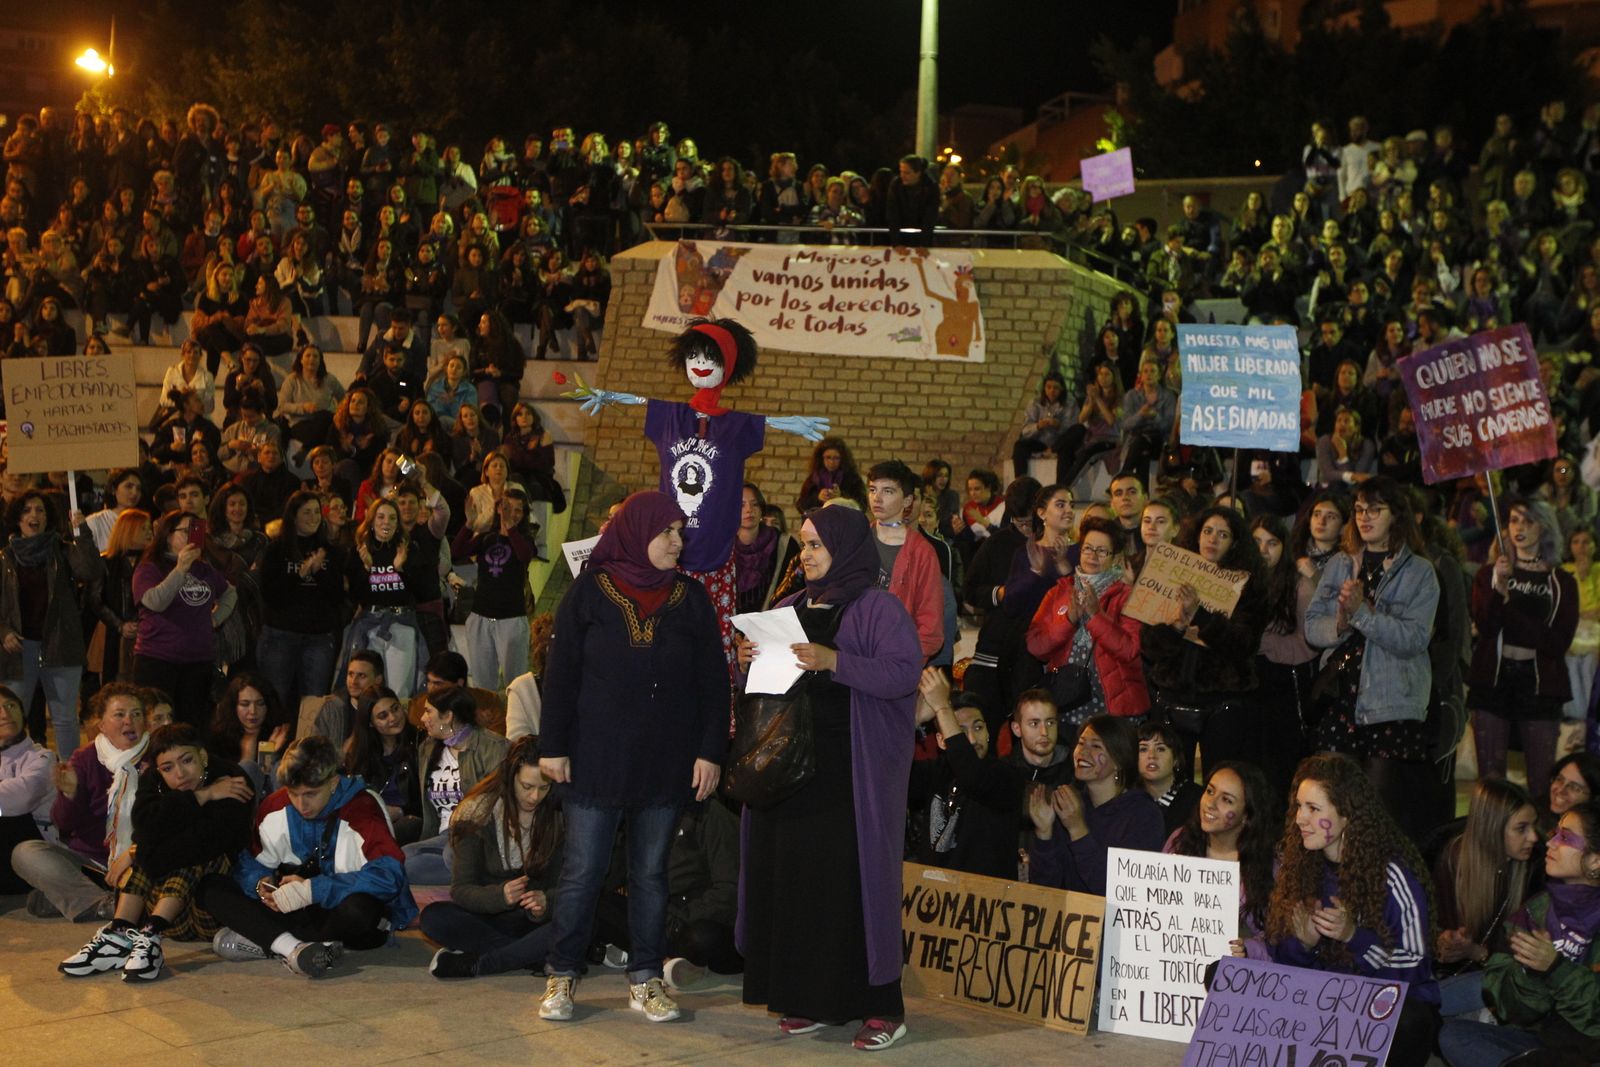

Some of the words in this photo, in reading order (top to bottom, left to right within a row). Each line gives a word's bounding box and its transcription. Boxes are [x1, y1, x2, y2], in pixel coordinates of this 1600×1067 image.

[752, 268, 823, 292] vamos
[831, 268, 909, 292] unidas
[735, 290, 775, 311] por
[781, 289, 811, 311] los
[818, 294, 921, 317] derechos
[769, 312, 795, 330] de
[804, 313, 867, 335] todas
[1185, 333, 1240, 347] MOLESTA
[1187, 353, 1229, 372] MUJER
[1235, 356, 1300, 375] LIBERADA
[1477, 343, 1502, 371] NO
[1501, 337, 1527, 365] SE
[12, 381, 133, 405] EMPODERADAS
[1209, 385, 1238, 398] QUE
[1248, 387, 1275, 400] MIL
[1462, 390, 1487, 415] NO
[1488, 378, 1541, 411] SIENTE
[43, 403, 94, 417] HARTAS
[101, 402, 117, 412] DE
[1442, 424, 1472, 449] SUS
[1477, 402, 1549, 442] CADENAS
[1150, 560, 1168, 572] SE
[1156, 545, 1179, 561] CON
[1180, 554, 1191, 566] EL
[1192, 559, 1240, 584] MACHISMO
[371, 581, 405, 592] ROLES
[1139, 576, 1162, 593] CON
[1161, 586, 1173, 600] EL
[1117, 857, 1169, 882] MOLARÍA
[1173, 863, 1192, 883] NO
[1197, 869, 1232, 886] TENER
[1115, 885, 1137, 902] QUE
[1147, 887, 1184, 906] MIRAR
[1194, 892, 1222, 910] PARA
[1021, 903, 1100, 958] PLACE
[1112, 907, 1162, 932] ATRÁS
[1168, 915, 1183, 931] AL
[1191, 917, 1225, 935] ABRIR
[1135, 934, 1151, 951] EL
[919, 934, 959, 973] THE
[954, 934, 1094, 1025] RESISTANCE
[1110, 956, 1150, 981] PRODUCE
[1159, 958, 1206, 985] TORTÍC
[1213, 964, 1291, 1001] SOMOS
[1112, 988, 1127, 1000] EN
[1110, 1005, 1128, 1022] LA
[1140, 990, 1204, 1027] LIBERT
[1310, 1014, 1339, 1050] YA
[1346, 1018, 1390, 1053] NO
